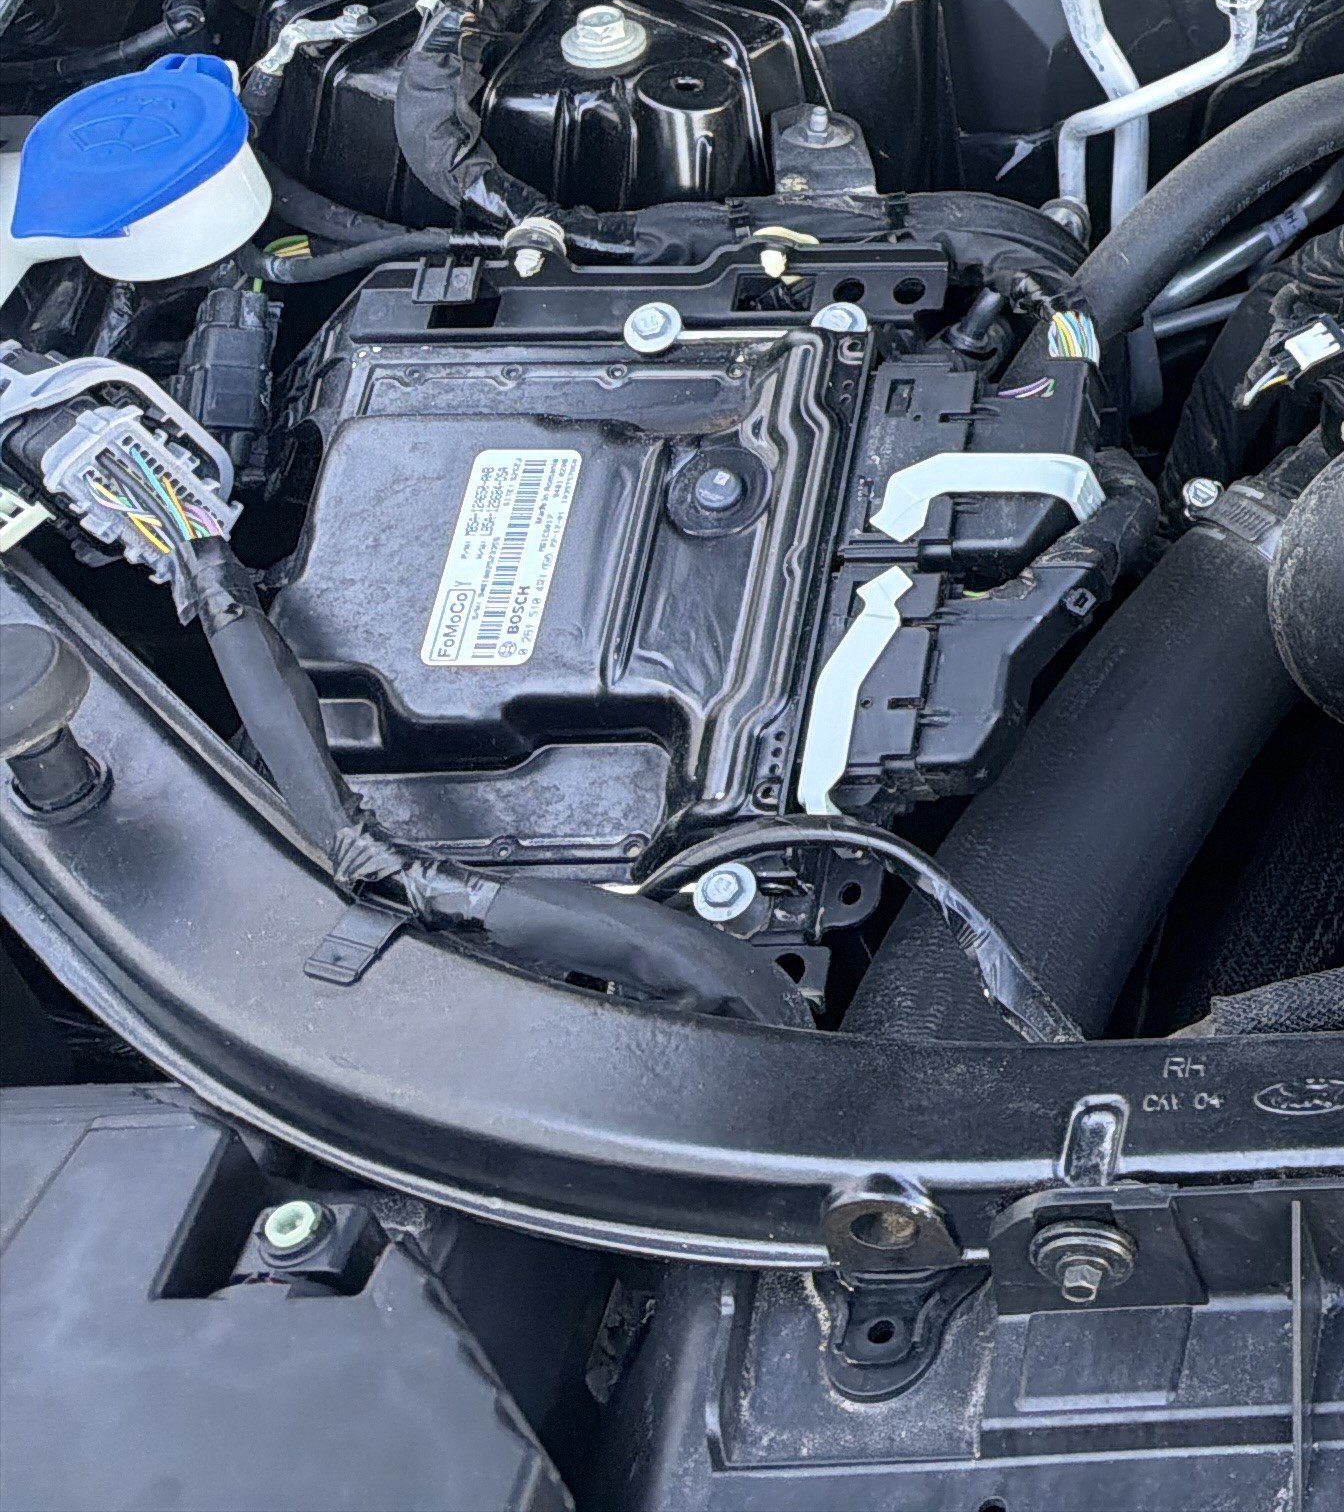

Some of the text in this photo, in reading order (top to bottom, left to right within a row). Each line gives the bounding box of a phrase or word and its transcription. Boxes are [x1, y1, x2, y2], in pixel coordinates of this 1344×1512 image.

[438, 592, 468, 658] FoMoCo
[506, 585, 530, 634] BOSCH
[1162, 1056, 1206, 1078] RH
